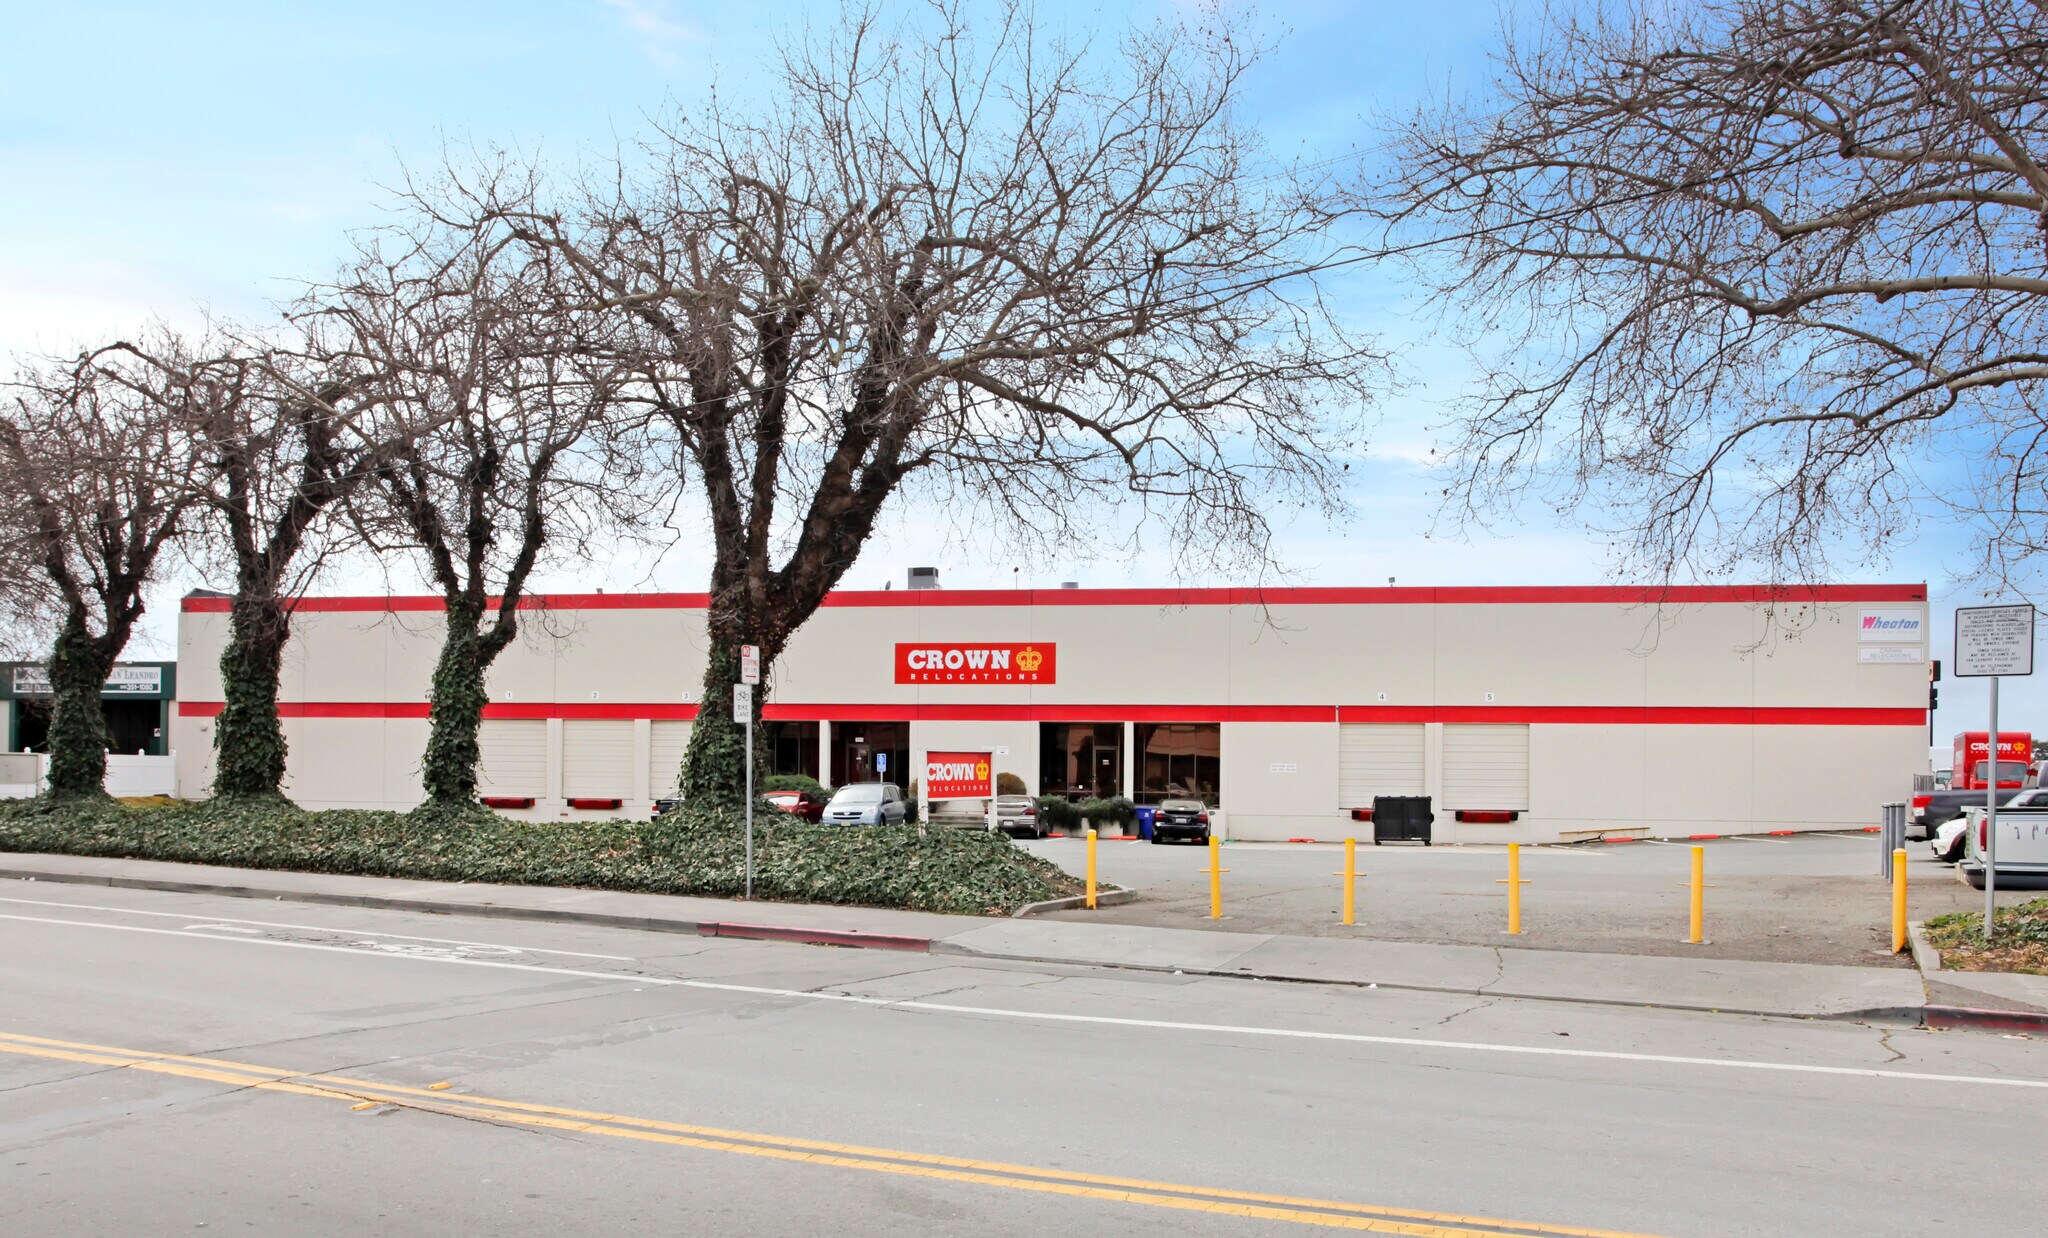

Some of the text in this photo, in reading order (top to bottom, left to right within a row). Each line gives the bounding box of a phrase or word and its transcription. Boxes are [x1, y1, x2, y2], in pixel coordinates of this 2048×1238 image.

[1862, 616, 1920, 629] Wheaton
[907, 650, 1010, 670] CROWN
[124, 670, 158, 680] LEANDRO
[927, 763, 974, 781] CROWN
